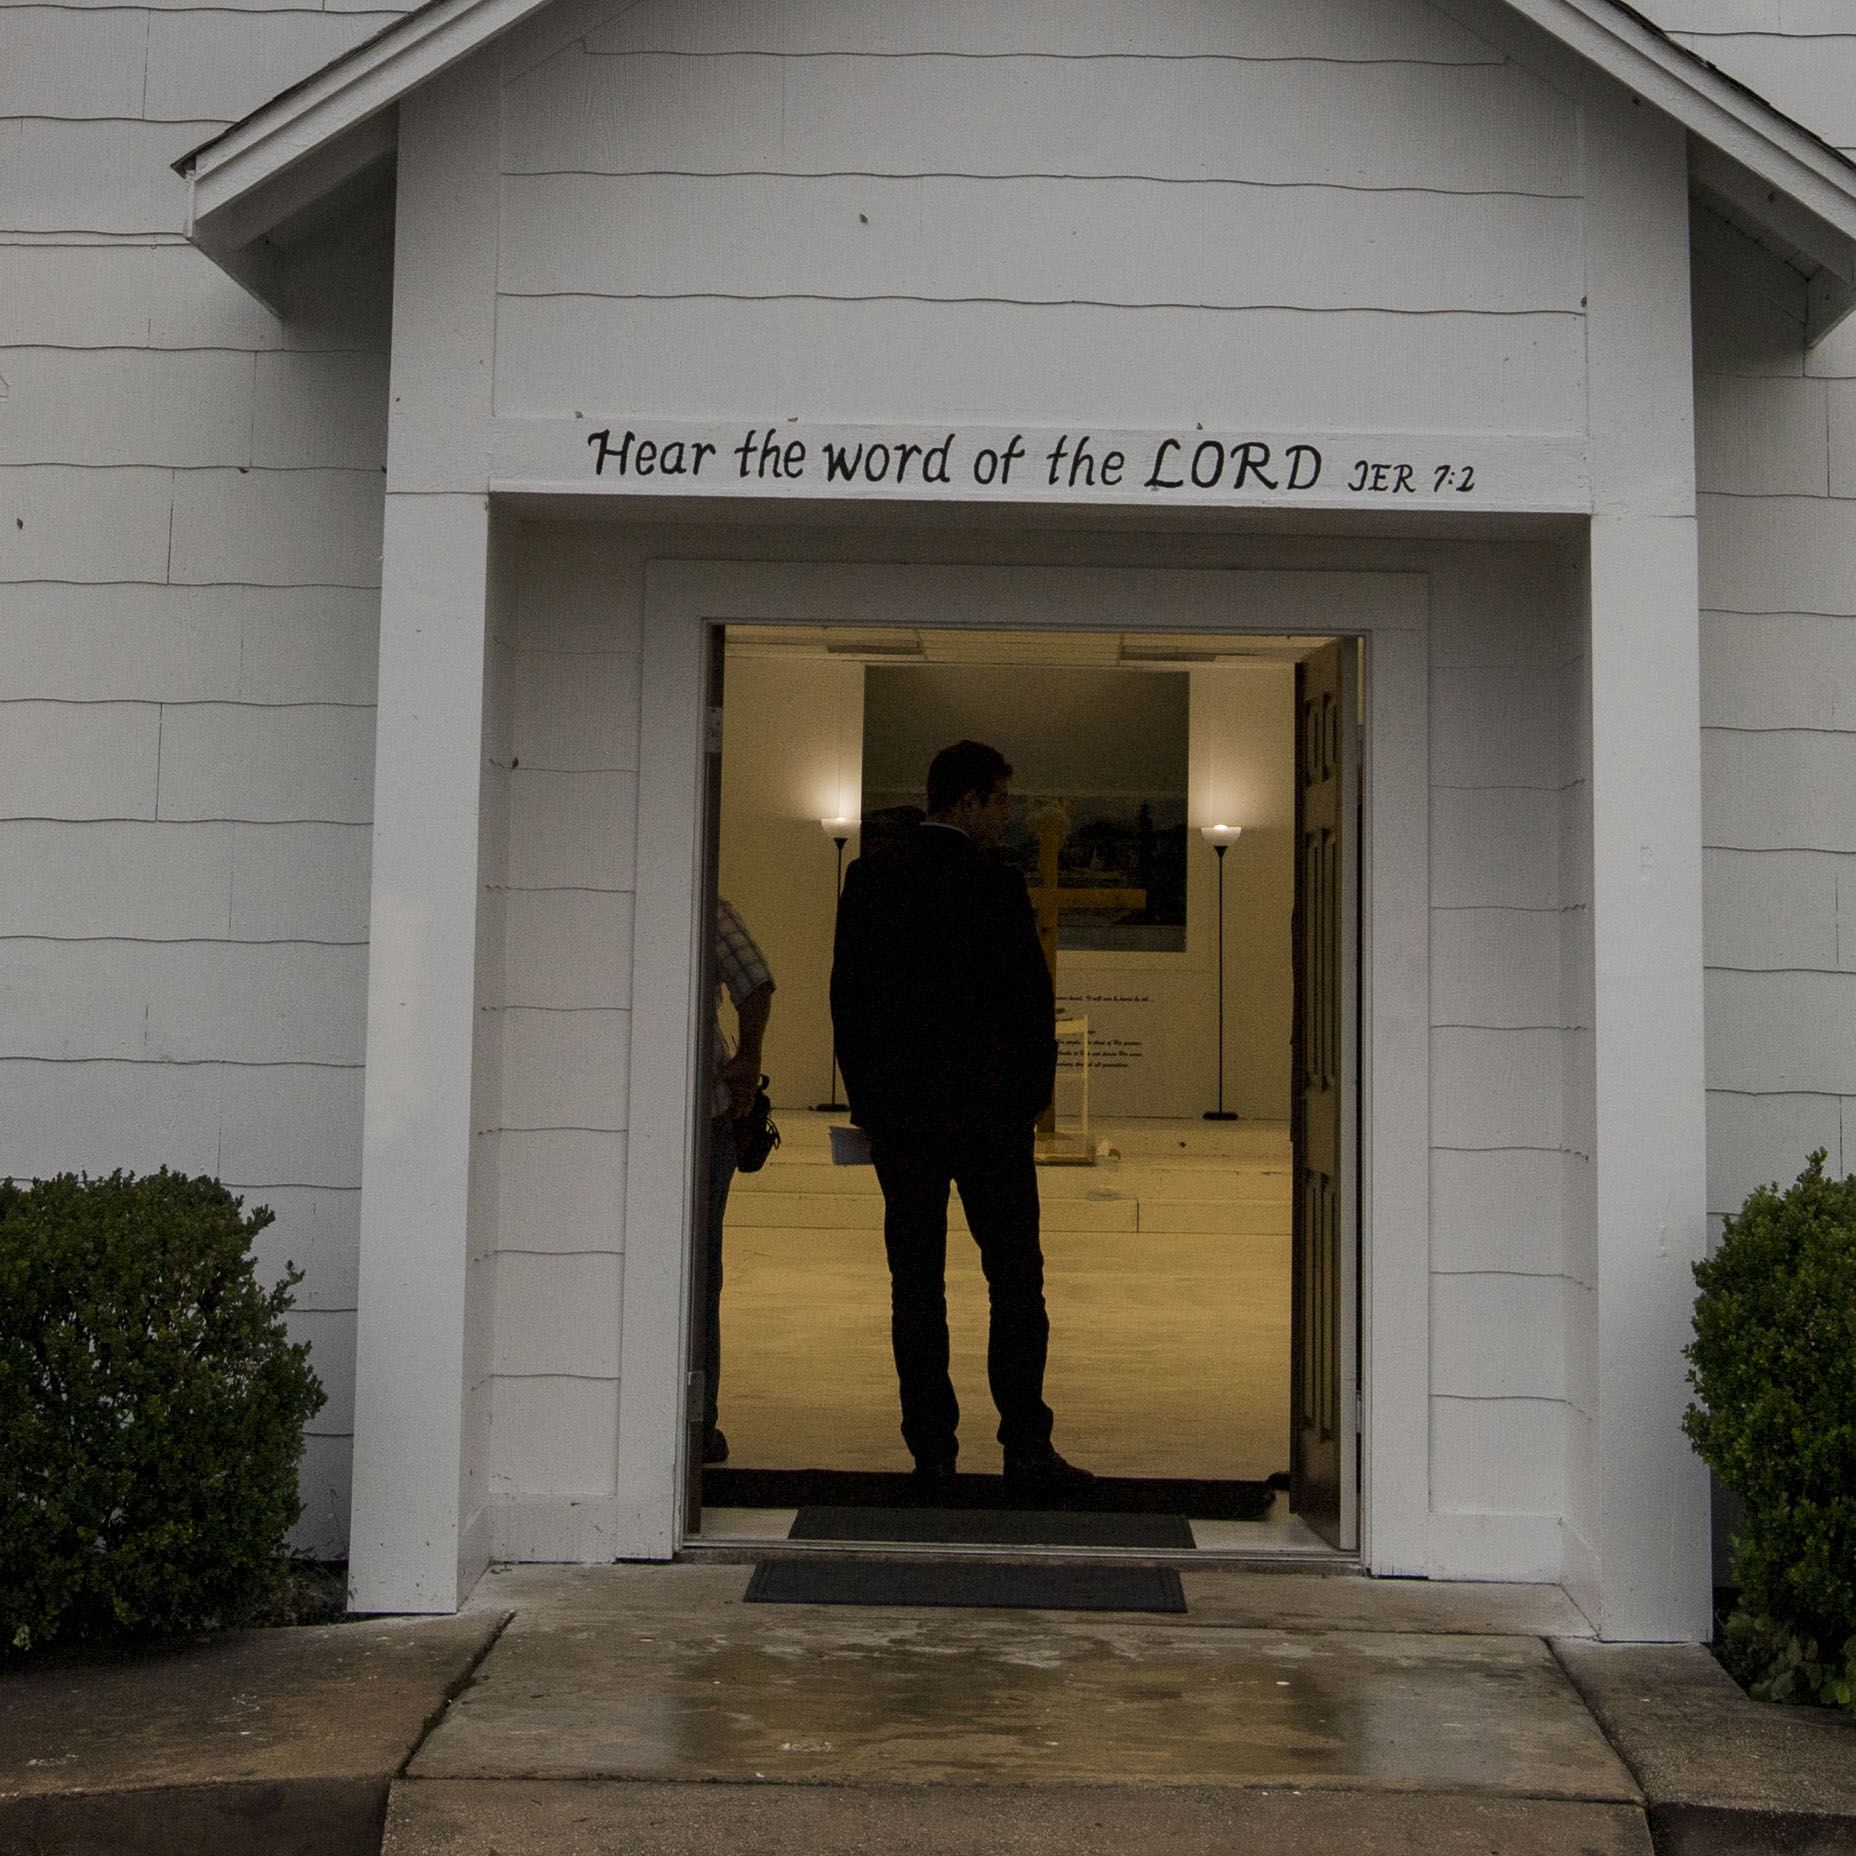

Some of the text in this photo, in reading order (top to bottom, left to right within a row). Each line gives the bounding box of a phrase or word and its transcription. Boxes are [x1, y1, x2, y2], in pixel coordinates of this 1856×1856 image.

[586, 427, 1475, 494] Hear the word of the LORD JER 7:2
